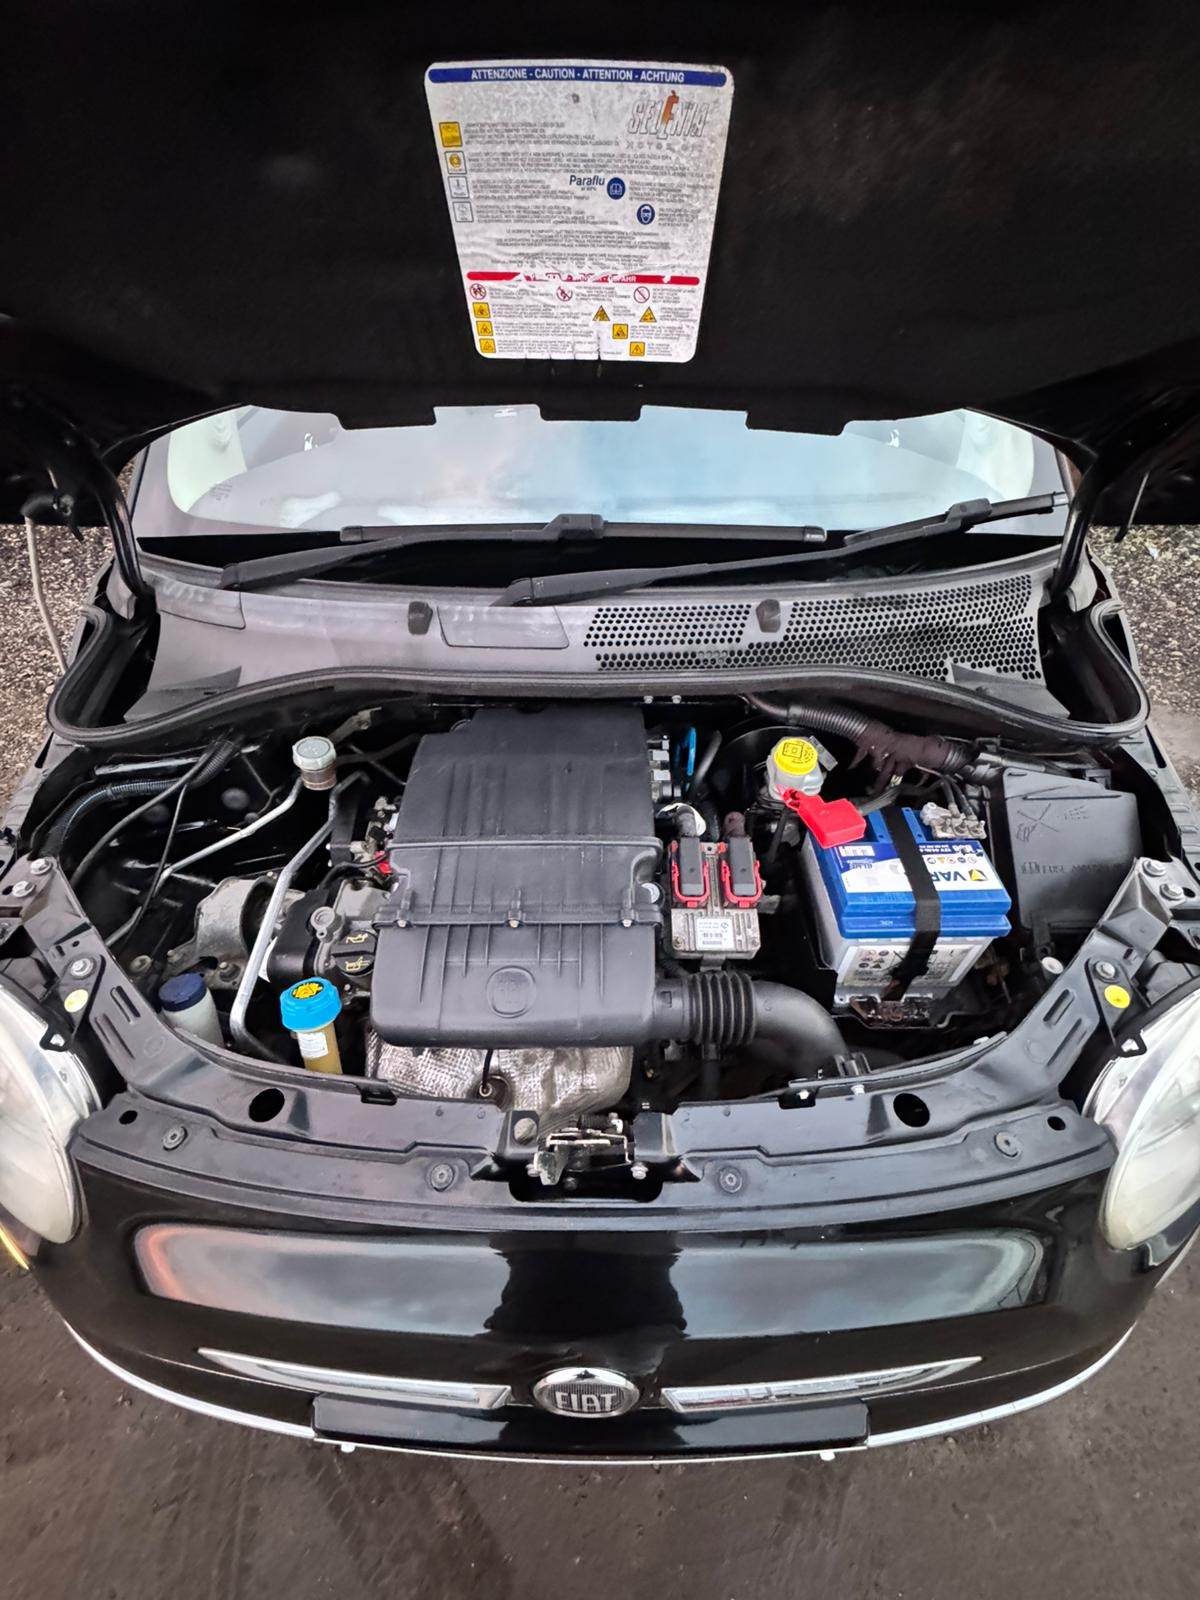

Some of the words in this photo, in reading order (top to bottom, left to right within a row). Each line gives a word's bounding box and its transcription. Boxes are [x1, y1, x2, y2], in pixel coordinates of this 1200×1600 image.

[471, 69, 528, 80] ATTENZIONE
[535, 68, 575, 79] CAUTION
[582, 69, 632, 80] ATTENTION
[640, 72, 685, 83] ACHTUNG
[569, 175, 605, 187] Paraflu
[931, 871, 967, 882] VAR
[555, 1391, 617, 1412] FIAT
